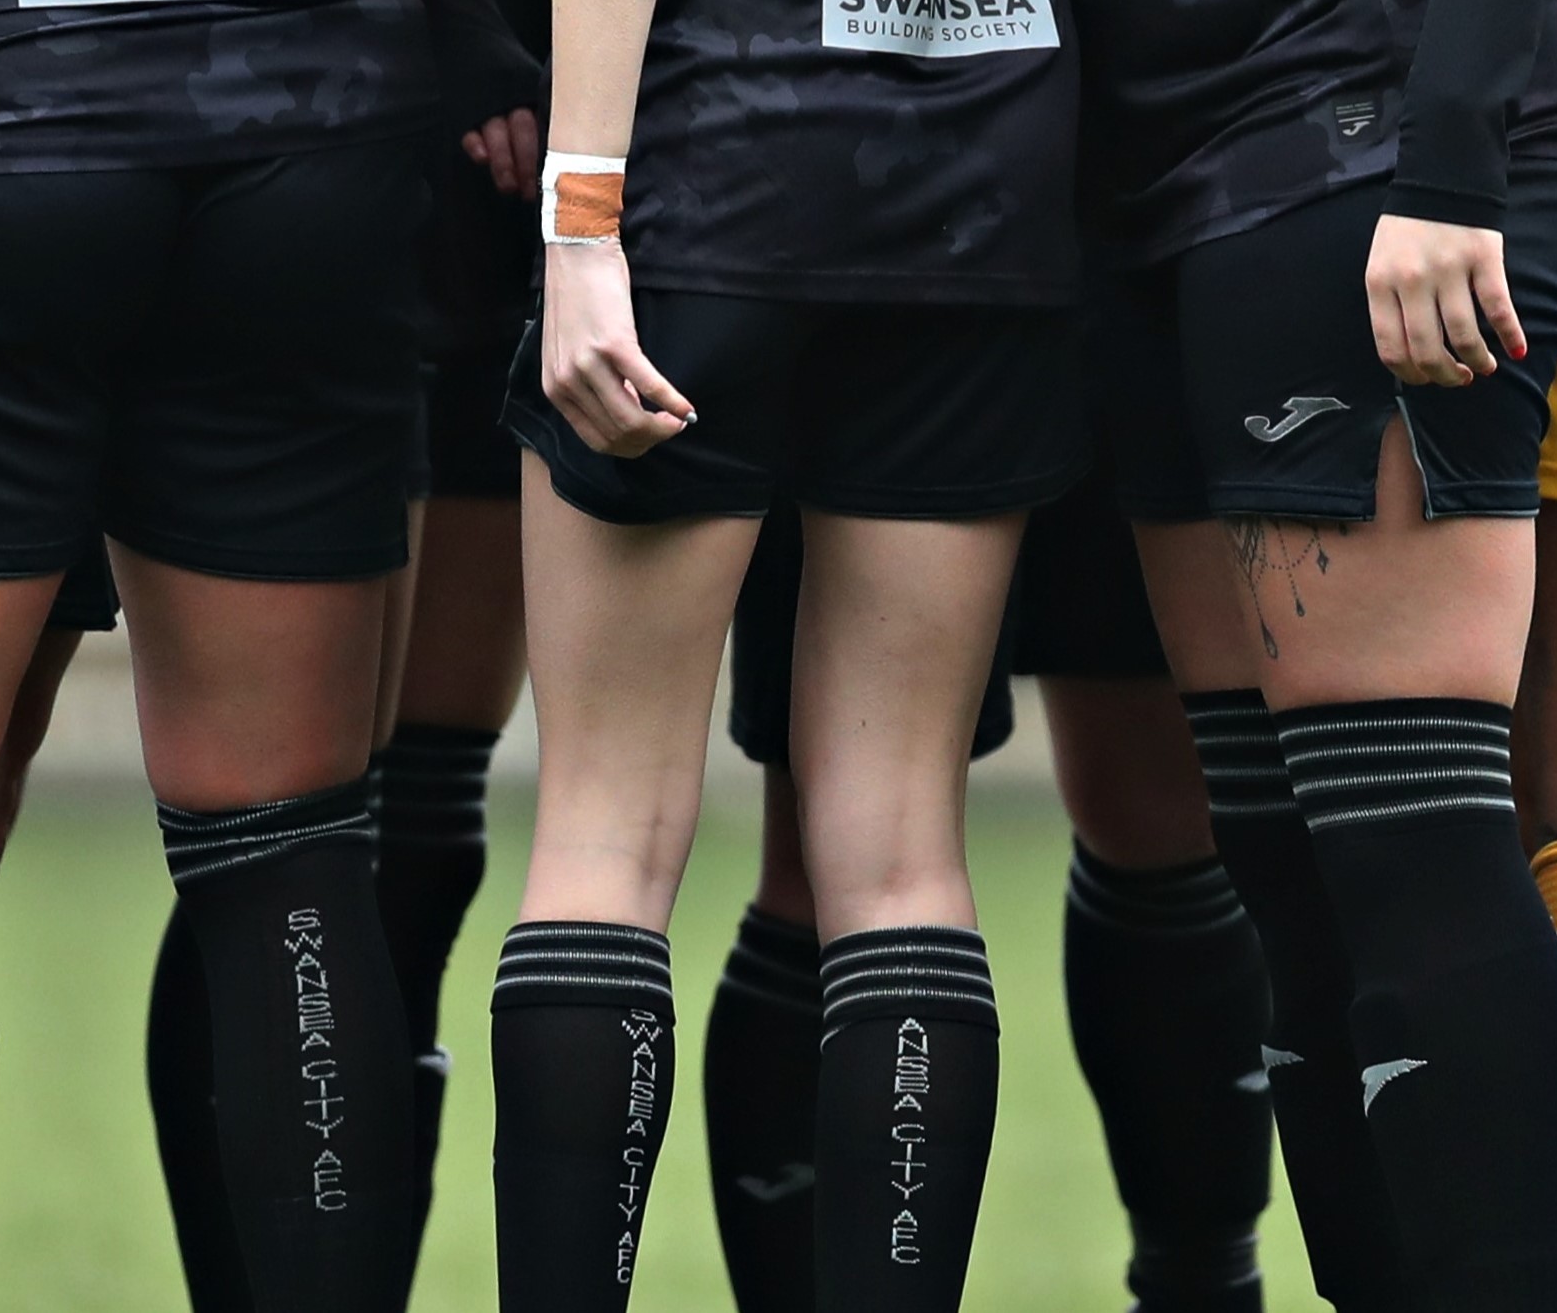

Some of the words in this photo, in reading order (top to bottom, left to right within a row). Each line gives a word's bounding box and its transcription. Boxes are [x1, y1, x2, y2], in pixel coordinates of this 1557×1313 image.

[846, 19, 935, 44] BUILDING
[943, 20, 1034, 44] SOCIETY
[285, 908, 335, 1050] SWANSEA
[302, 1059, 344, 1138] CITY
[622, 1009, 663, 1137] SWANSEA
[894, 1017, 930, 1111] ANSEA
[314, 1149, 347, 1212] AFC
[618, 1147, 645, 1223] CITY
[891, 1124, 927, 1200] CITY
[617, 1231, 634, 1284] AFC
[890, 1209, 921, 1265] AFC
